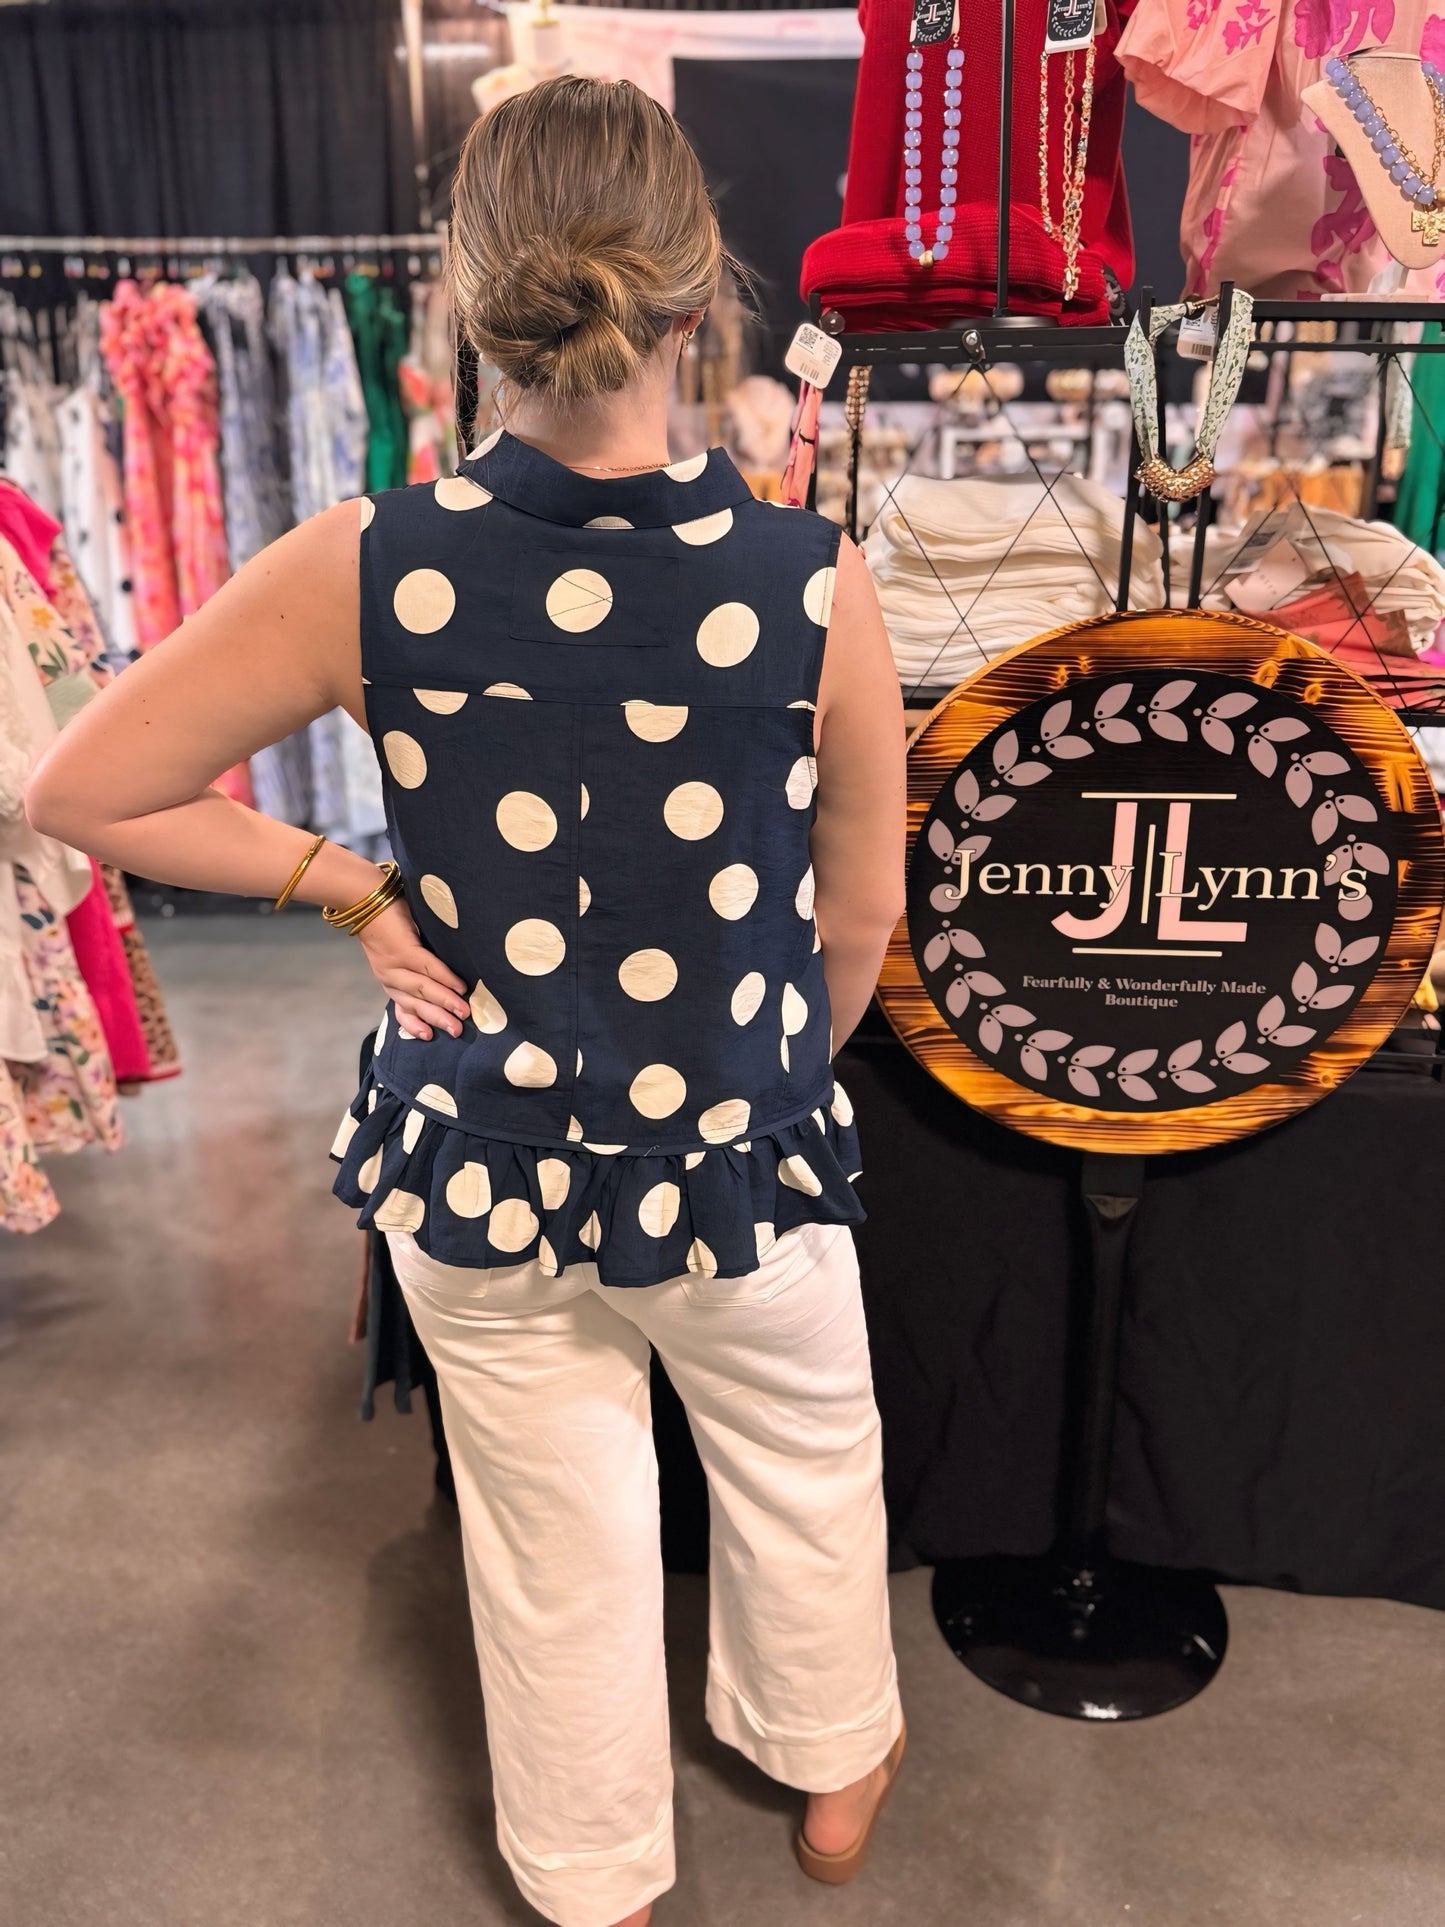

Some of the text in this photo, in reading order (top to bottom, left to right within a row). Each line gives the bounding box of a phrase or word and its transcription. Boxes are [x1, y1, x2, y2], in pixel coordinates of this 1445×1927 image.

[944, 848, 1368, 911] Jenny Lynn's
[1051, 802, 1248, 942] JL
[1022, 975, 1267, 995] Fearfully & Wonderfully Made
[1104, 993, 1178, 1010] Boutique
